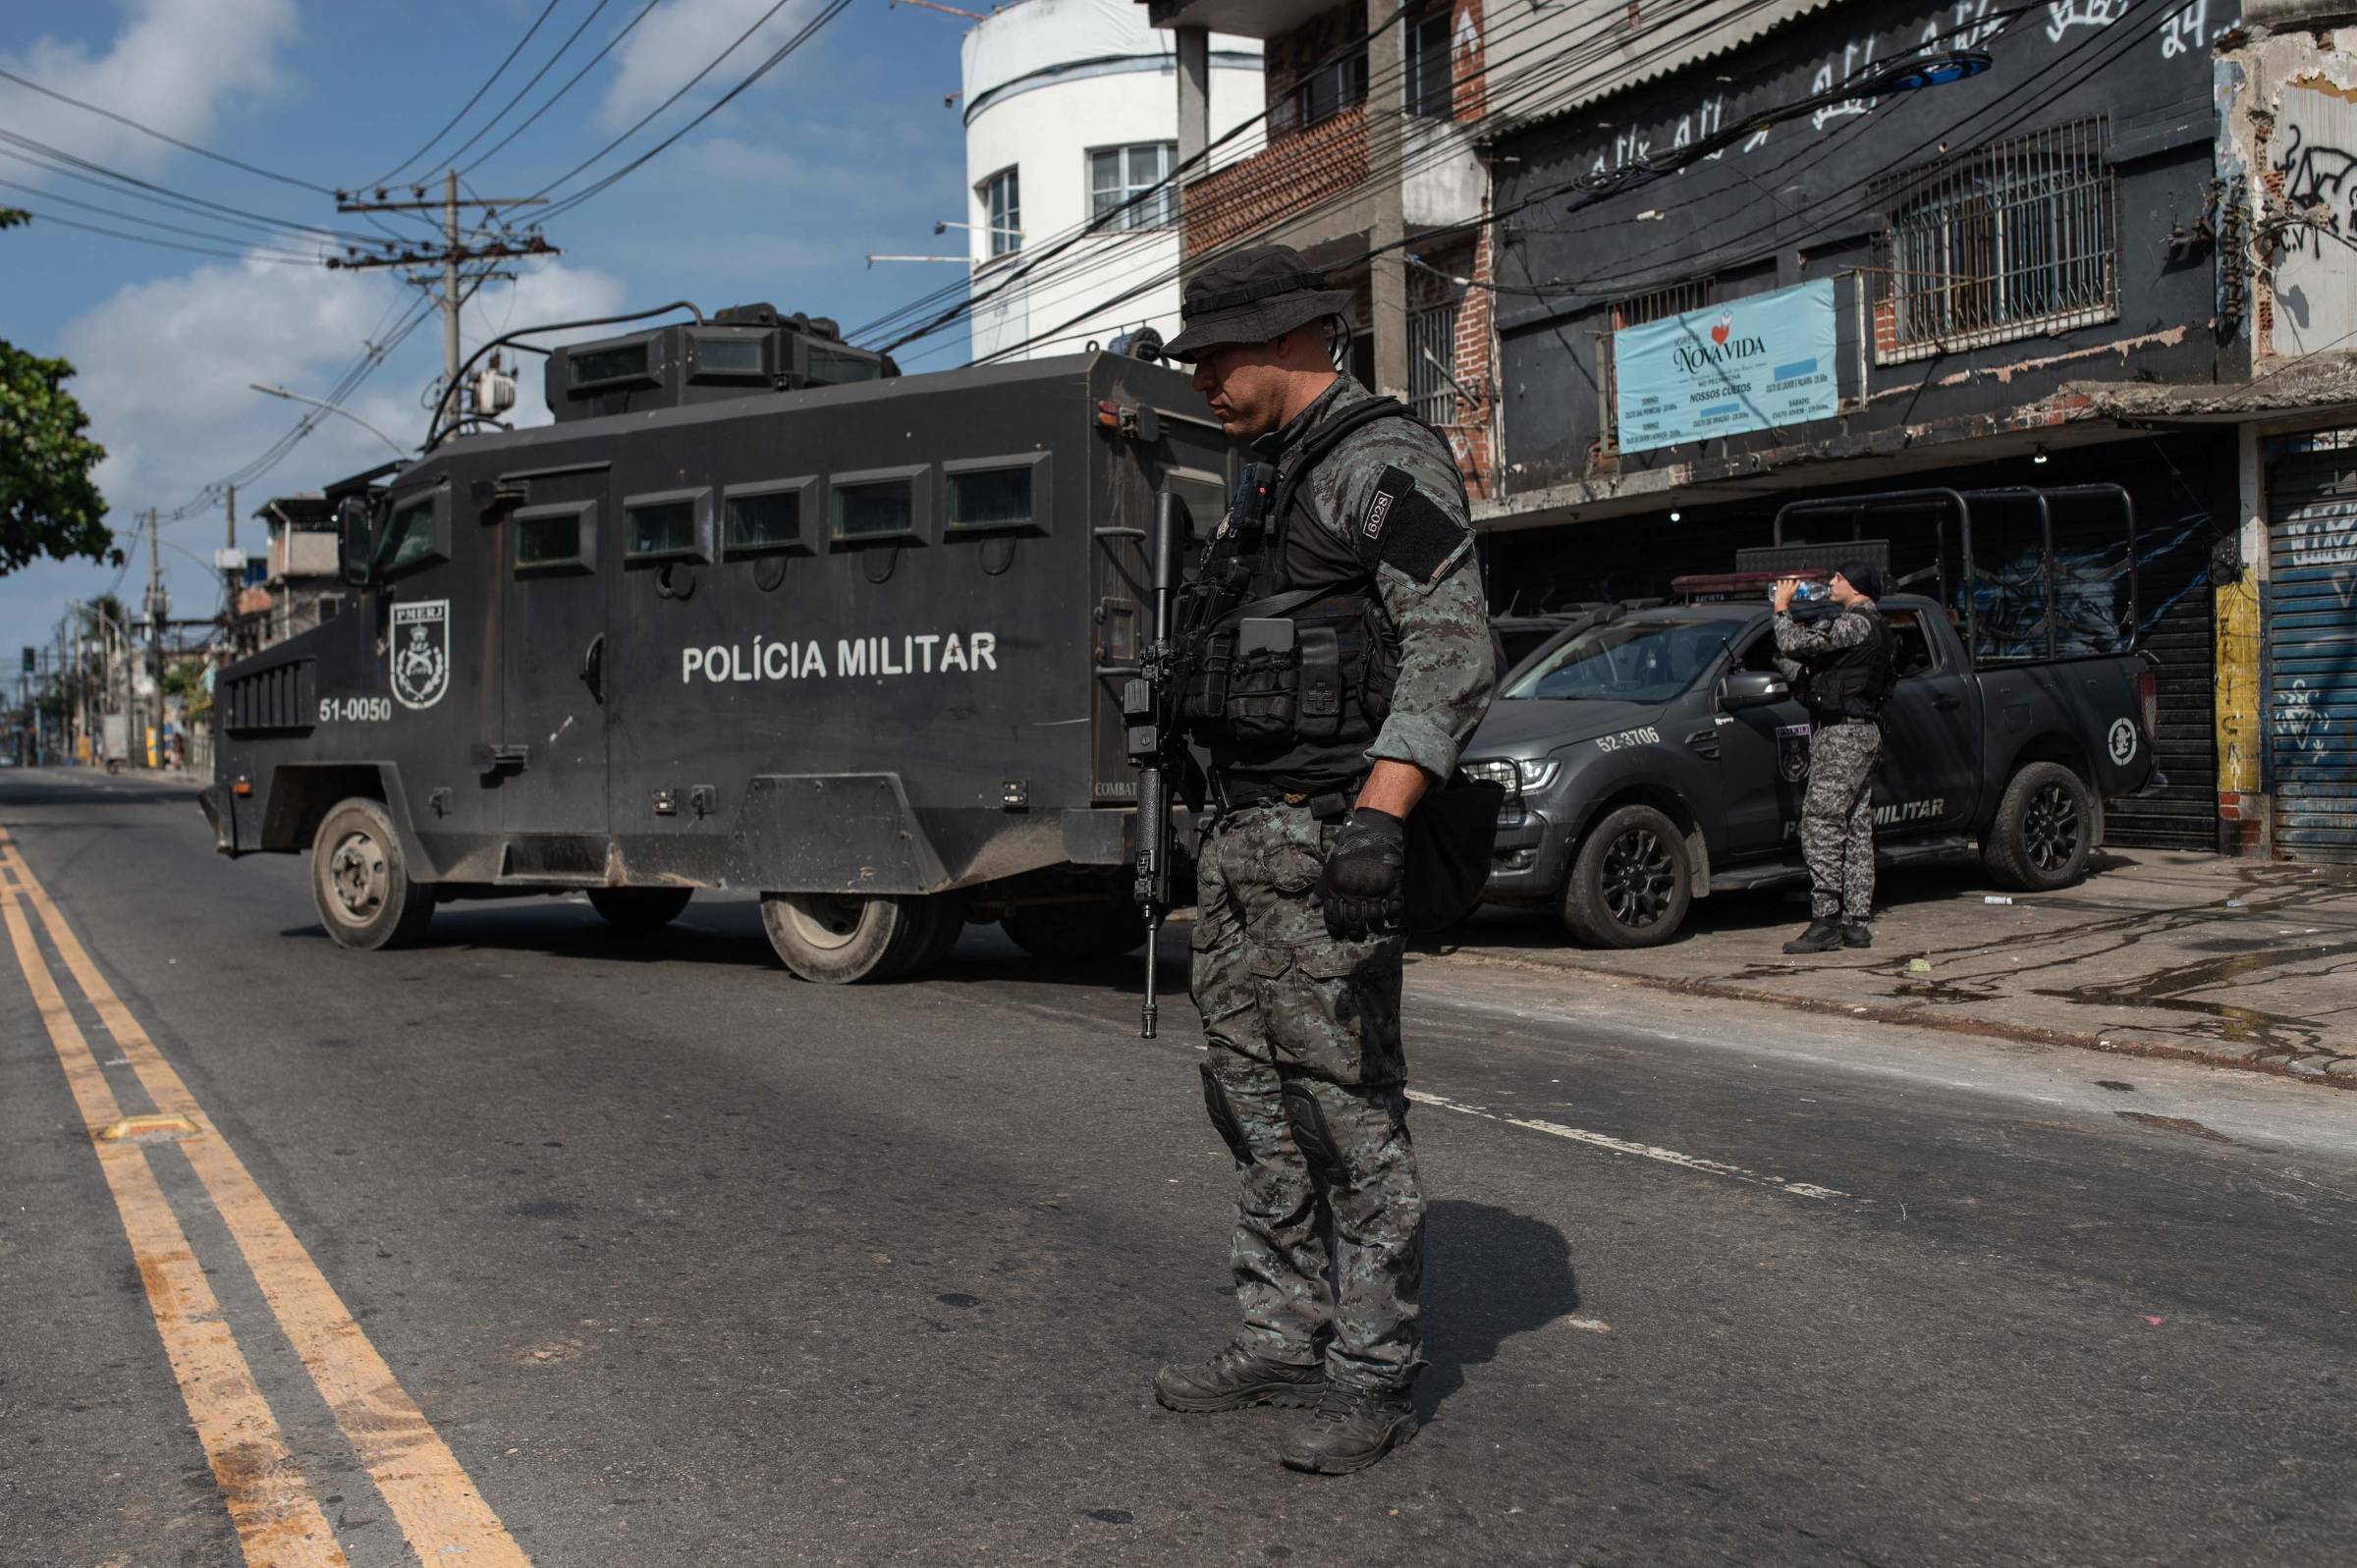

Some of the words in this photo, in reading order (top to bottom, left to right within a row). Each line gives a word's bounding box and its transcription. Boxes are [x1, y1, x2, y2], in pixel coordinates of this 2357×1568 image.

[1724, 336, 1766, 360] VIDA
[1690, 389, 1721, 404] NOSSOS
[1722, 382, 1752, 397] CULTOS
[1367, 496, 1389, 532] 6028
[397, 607, 443, 621] PMERJ
[682, 634, 827, 684] POLÍCIA
[838, 631, 997, 677] MILITAR
[319, 697, 392, 722] 51-0050
[1595, 726, 1661, 753] 52-3706
[1871, 797, 1945, 826] MILITAR
